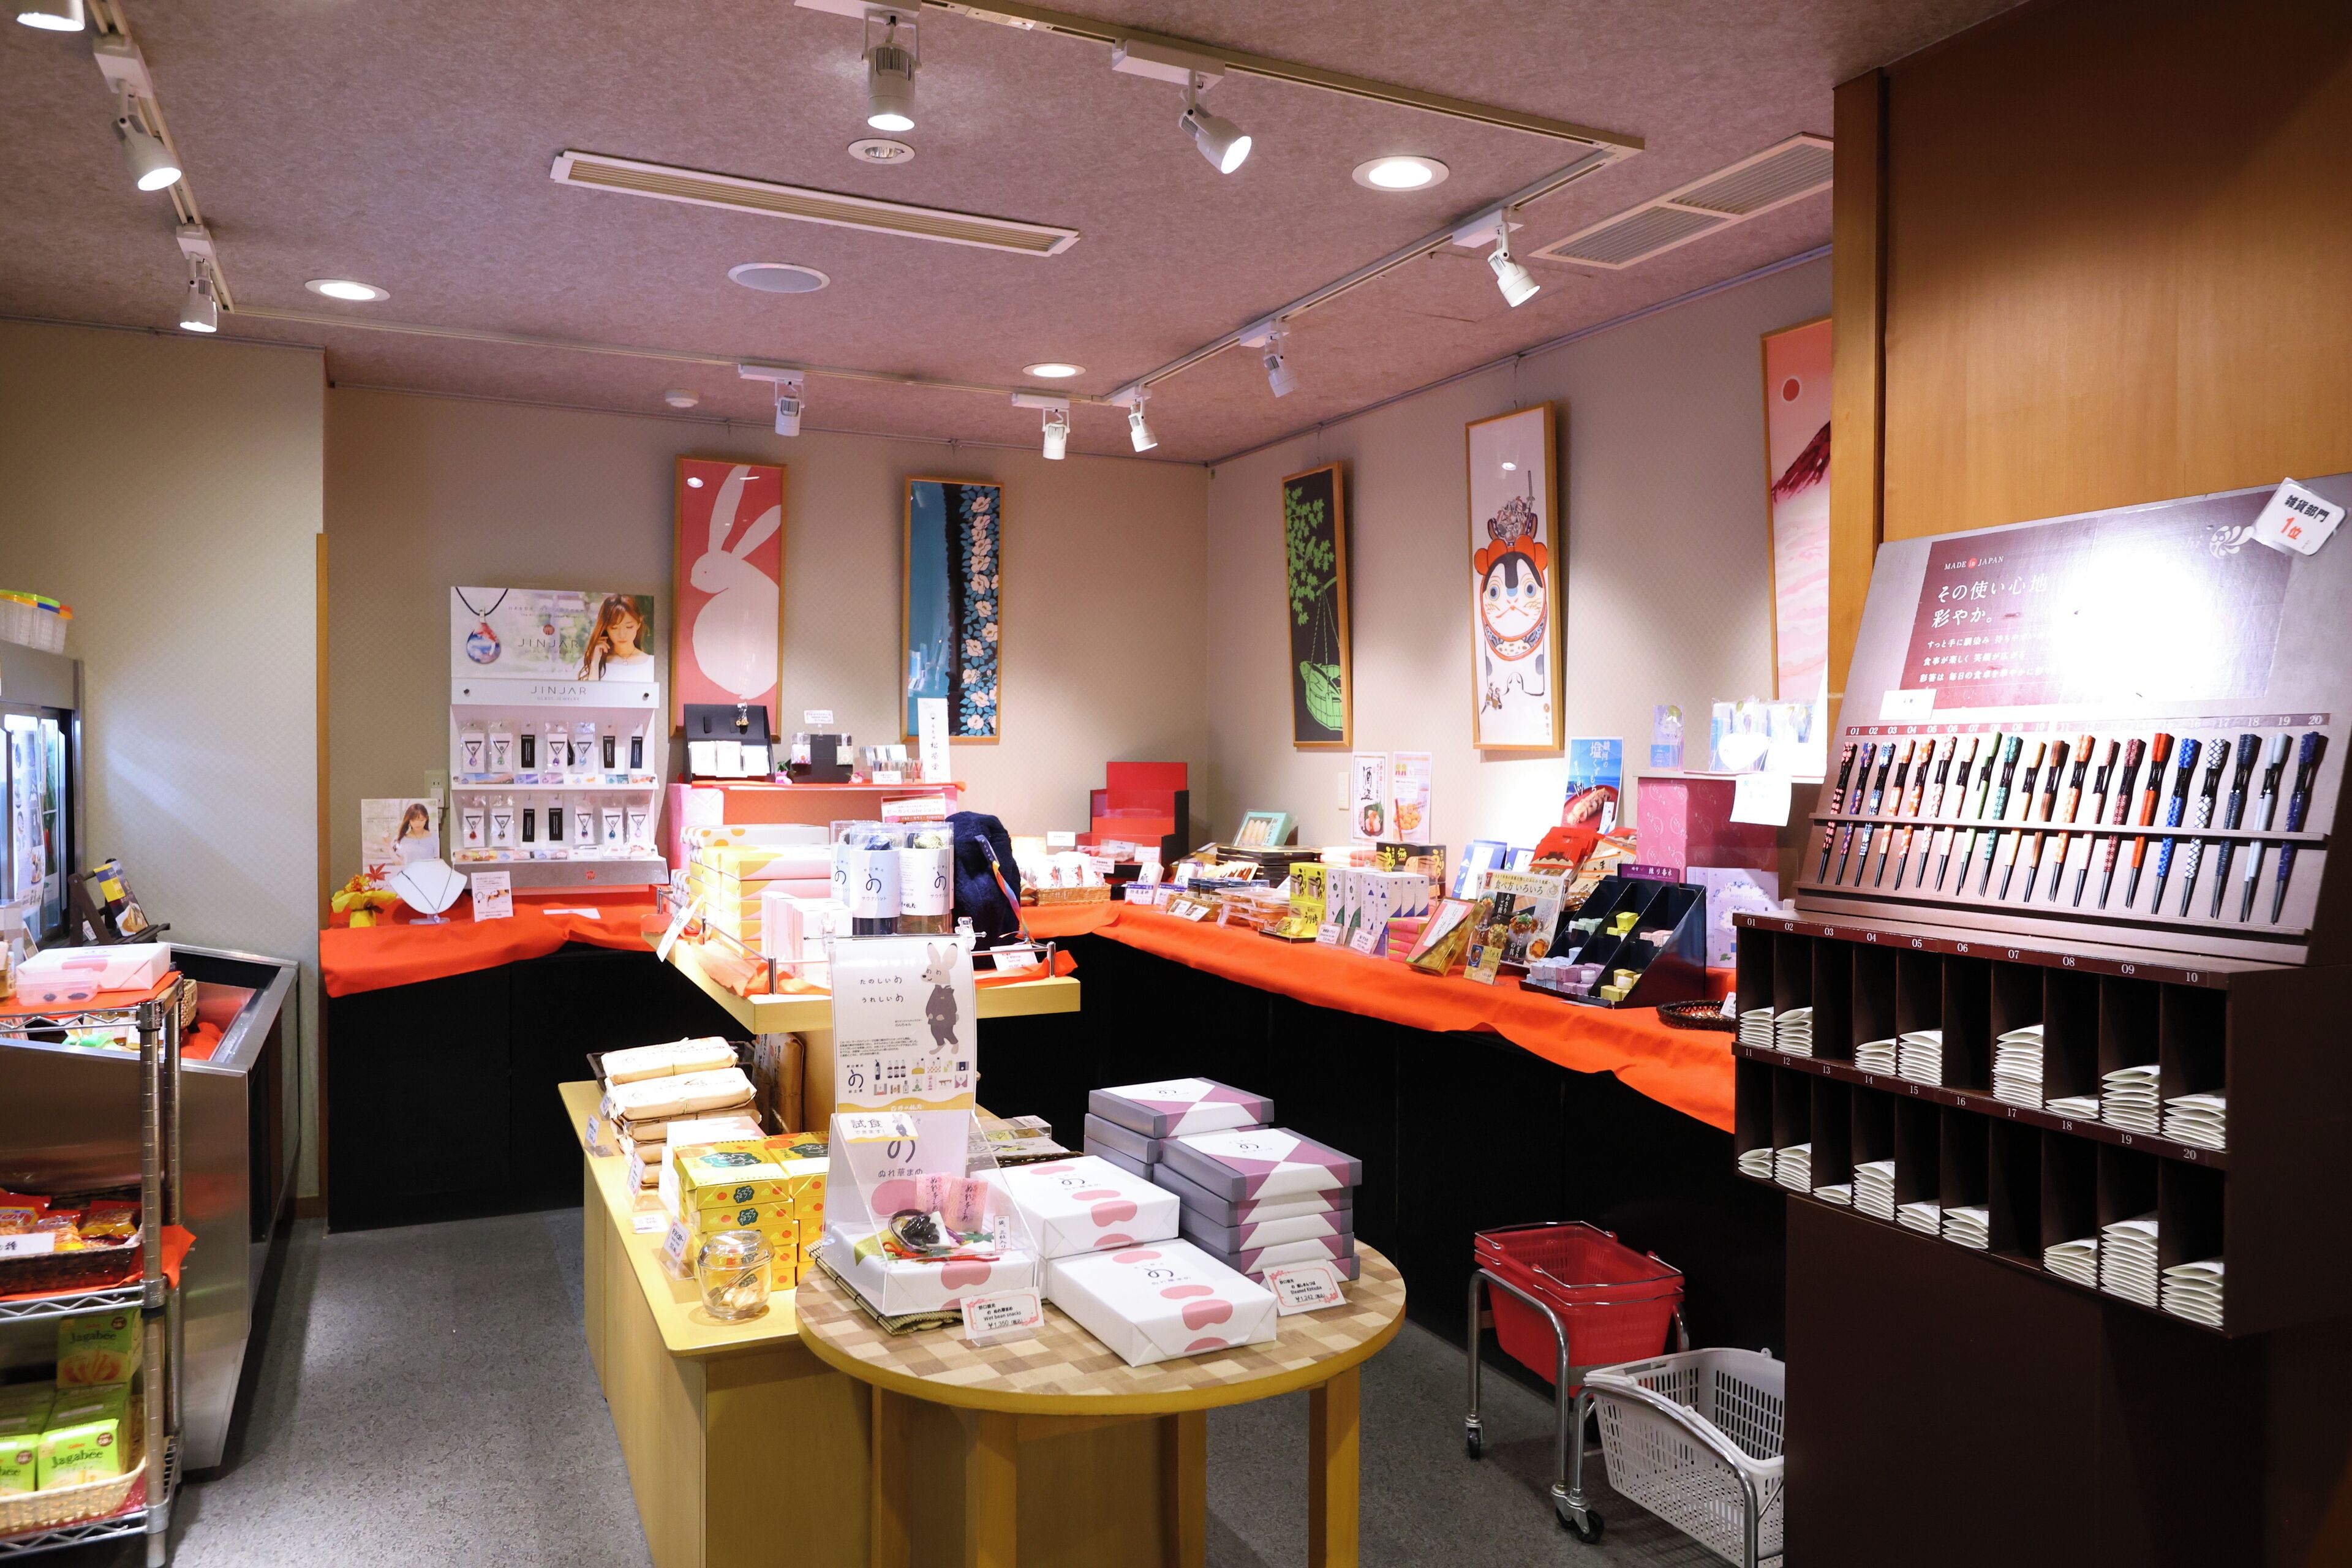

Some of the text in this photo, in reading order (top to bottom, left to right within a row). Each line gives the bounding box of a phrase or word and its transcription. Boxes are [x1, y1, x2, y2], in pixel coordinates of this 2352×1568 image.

[2284, 494, 2330, 522] 雑貨部門
[2280, 517, 2303, 540] 1位
[1944, 560, 1967, 570] MADE
[1978, 556, 2004, 567] JAPAN
[1937, 573, 2048, 603] その使い心地
[1932, 606, 1992, 628] 彩やか。
[518, 638, 579, 649] JINJAR
[1927, 636, 1989, 649] すっと手に馴染み
[1923, 650, 2026, 666] 食事が楽しく 笑顔が広がる
[531, 686, 587, 695] JINJAR
[2218, 718, 2230, 728] 17
[2248, 717, 2260, 726] 18
[2278, 716, 2290, 726] 19
[2308, 715, 2323, 725] 20
[1887, 726, 1897, 734] 03
[1907, 725, 1917, 734] 04
[1947, 725, 1958, 733] 06
[1968, 724, 1980, 733] 07
[1601, 741, 1610, 767] 駿河の
[1590, 741, 1603, 792] 塩くずもち
[1494, 880, 1544, 895] 食べ方 いろいろ
[1785, 922, 1793, 931] 02
[1825, 927, 1834, 936] 03
[1867, 933, 1876, 942] 04
[1912, 938, 1922, 948] 05
[1957, 943, 1968, 952] 06
[2008, 949, 2019, 959] 07
[2062, 956, 2075, 967] 08
[2121, 964, 2135, 974] 09
[860, 975, 902, 985] たのしいの
[2185, 973, 2198, 982] 10
[861, 993, 903, 1003] うれしいの
[1783, 1057, 1790, 1065] 12
[1823, 1066, 1831, 1074] 13
[1865, 1075, 1873, 1084] 14
[1910, 1085, 1918, 1095] 15
[1956, 1097, 1966, 1106] 16
[2007, 1108, 2017, 1118] 17
[850, 1118, 883, 1128] 試食
[2062, 1120, 2073, 1131] 18
[2121, 1134, 2132, 1144] 19
[2183, 1148, 2197, 1159] 20
[878, 1168, 923, 1178] ぬれ華まめ
[69, 1329, 118, 1344] Jagabee
[51, 1447, 104, 1468] Jagabee
